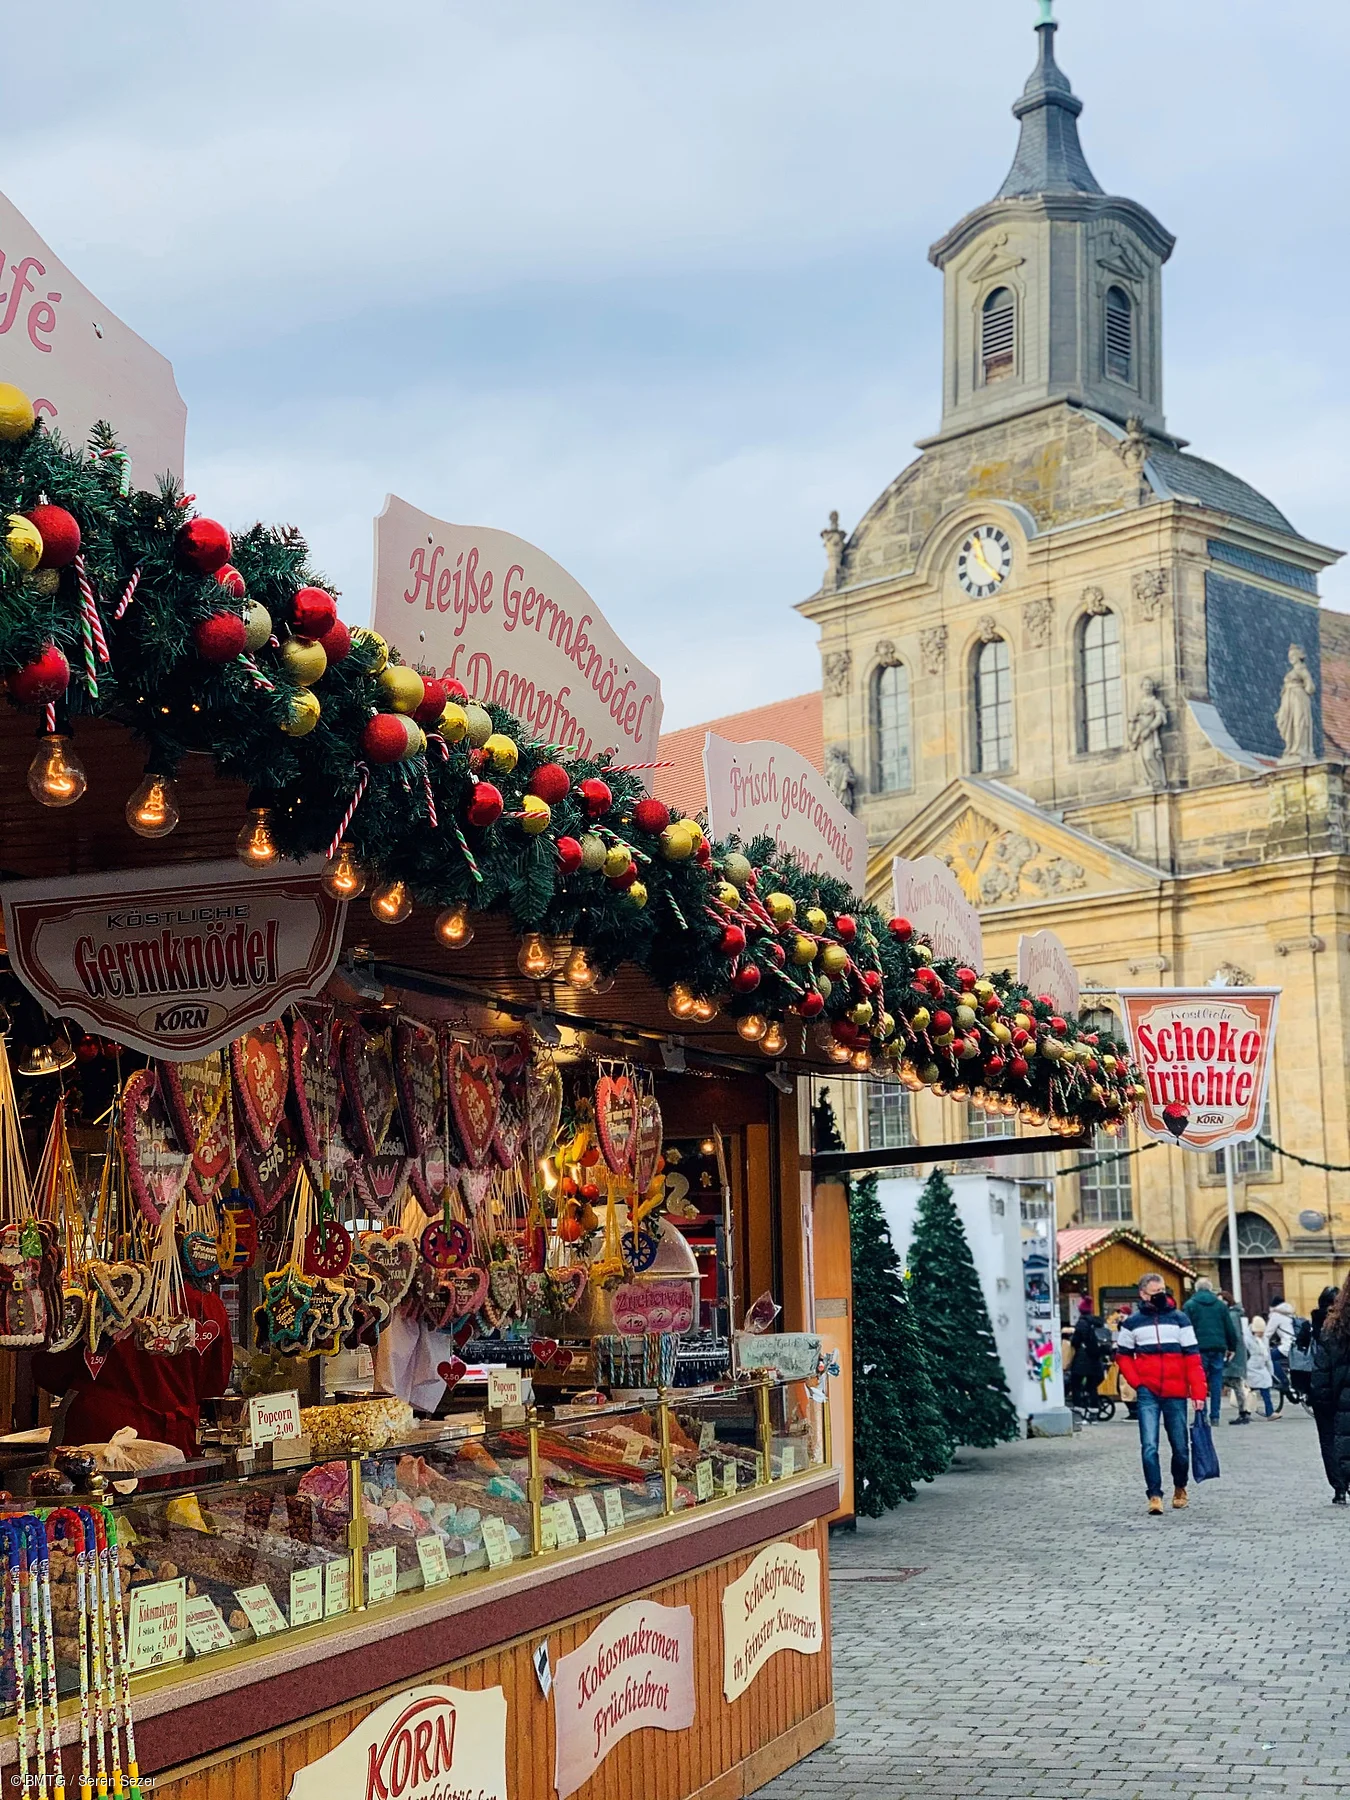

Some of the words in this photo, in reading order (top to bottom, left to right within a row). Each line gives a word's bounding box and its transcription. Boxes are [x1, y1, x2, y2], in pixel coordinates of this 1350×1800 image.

[0, 250, 62, 353] fé
[403, 545, 494, 637] Heiße
[502, 564, 653, 744] Germknödel
[729, 756, 779, 818] Frisch
[781, 772, 854, 873] gebrannte
[106, 904, 250, 930] KÖSTLICHE
[73, 918, 280, 1000] Germknödel
[153, 1003, 210, 1032] KORN
[1137, 1021, 1262, 1066] Schoko
[1146, 1064, 1253, 1107] früchte
[1195, 1112, 1225, 1125] KORN
[257, 1408, 293, 1427] Popcorn
[493, 1380, 517, 1395] Popcorn
[744, 1557, 806, 1622] Schokofrüchte
[577, 1616, 680, 1711] Kokosmakronen
[733, 1653, 744, 1682] in
[743, 1618, 776, 1683] feinster
[776, 1606, 818, 1640] Kuvertüre
[593, 1670, 670, 1759] Früchtebrot
[365, 1703, 457, 1800] KORN
